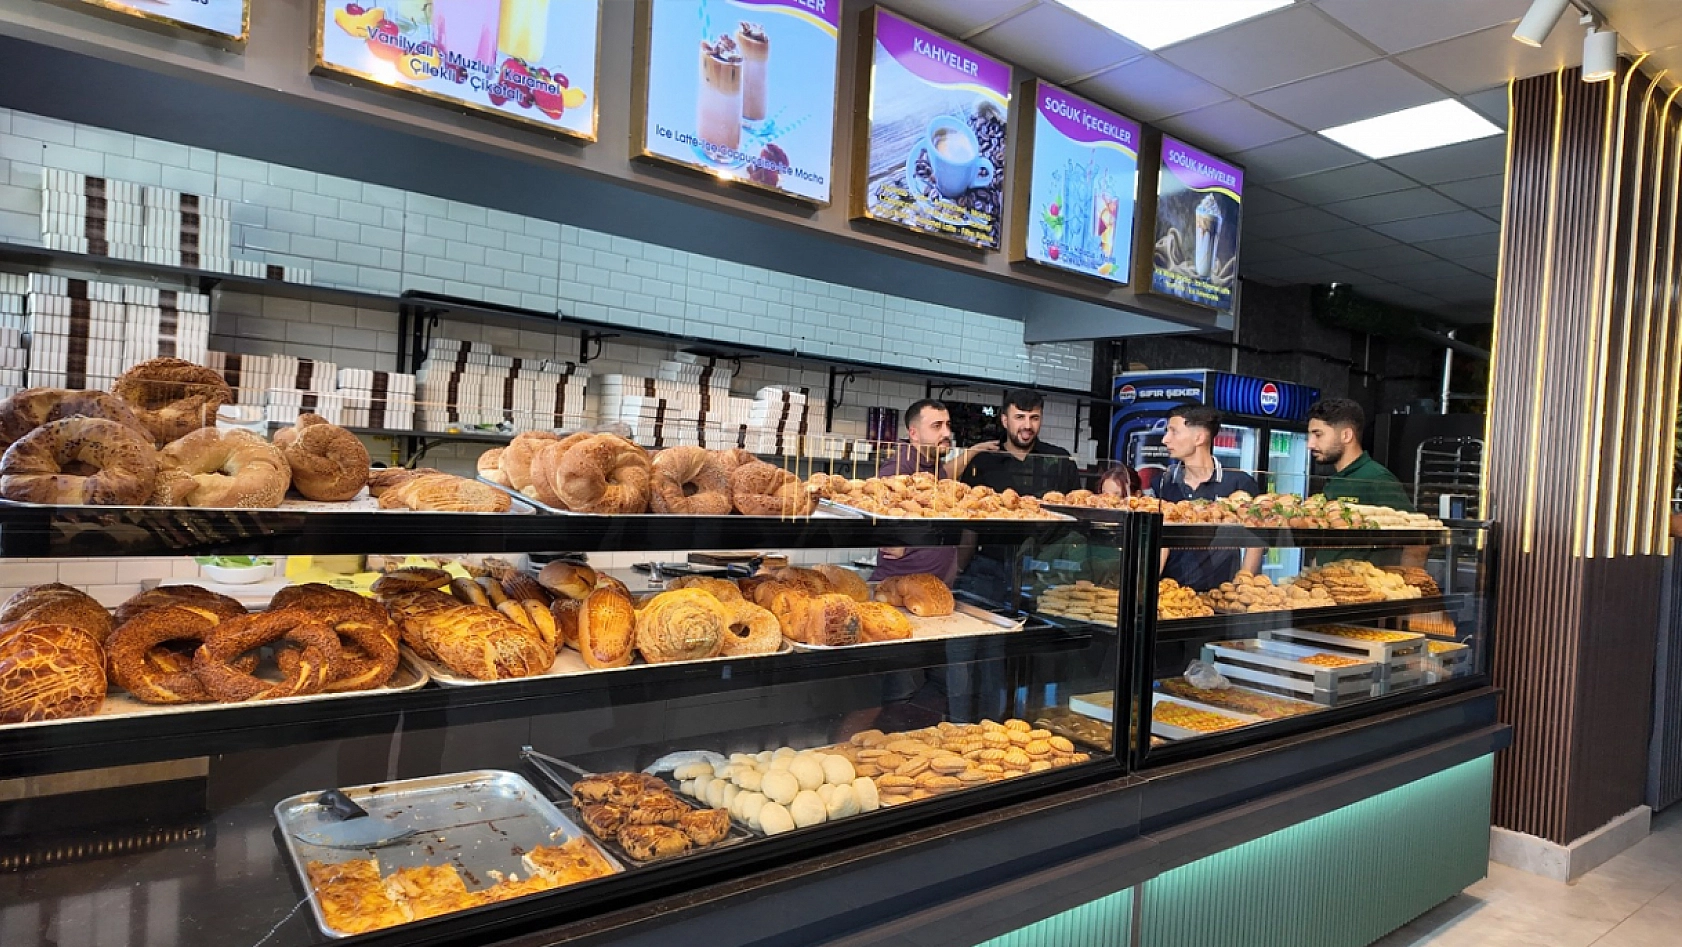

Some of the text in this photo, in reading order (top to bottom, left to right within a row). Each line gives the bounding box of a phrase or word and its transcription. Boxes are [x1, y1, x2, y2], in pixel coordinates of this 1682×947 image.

[410, 58, 457, 83] Çilekli
[449, 51, 489, 74] Muzlu
[505, 69, 560, 95] Karamel
[914, 37, 979, 77] KAHVELER
[1045, 97, 1131, 144] SOĞUK İÇECEKLER
[656, 124, 672, 139] Ice
[795, 167, 823, 184] Mocha
[1169, 150, 1236, 186] SOĞUK KAHVELER
[1166, 388, 1201, 399] ŞEKER
